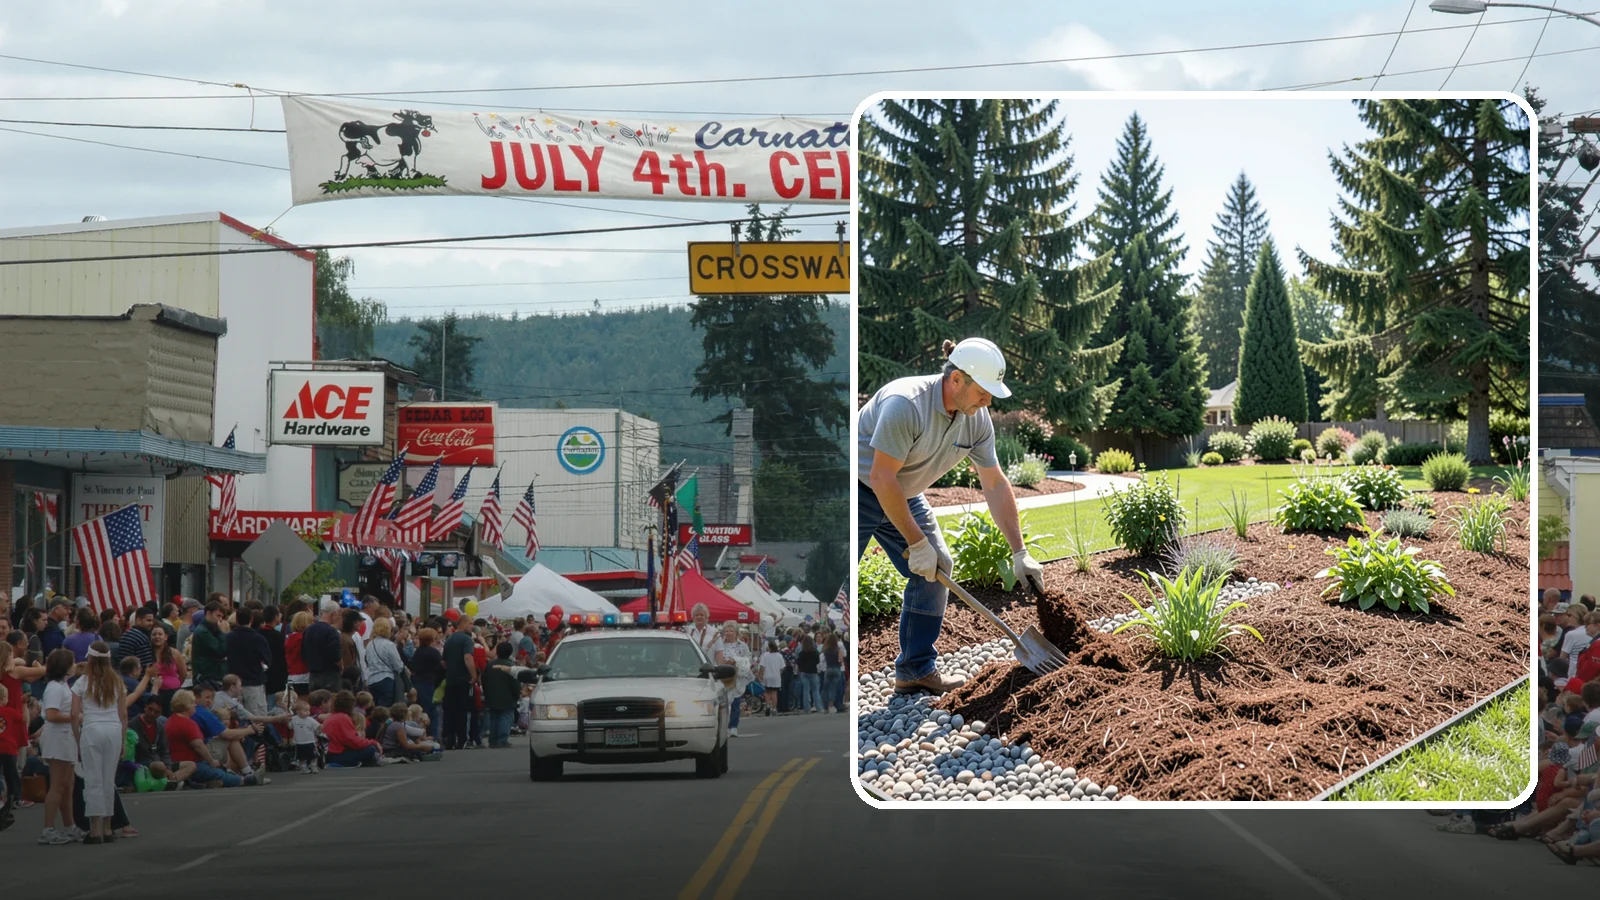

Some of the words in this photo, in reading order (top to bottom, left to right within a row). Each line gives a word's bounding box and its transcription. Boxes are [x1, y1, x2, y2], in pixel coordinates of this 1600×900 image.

[695, 121, 850, 150] Carnat
[481, 141, 605, 192] JULY
[632, 150, 746, 197] 4th.
[697, 254, 850, 280] CROSSWA
[283, 380, 374, 420] ACE
[406, 409, 453, 422] CEDAR
[283, 421, 370, 436] Hardware
[416, 428, 477, 447] Coca-Cola
[96, 485, 124, 494] Vincent
[126, 486, 135, 495] de
[138, 486, 155, 495] Paul
[688, 526, 741, 535] CRNATION
[699, 535, 730, 543] GLASS
